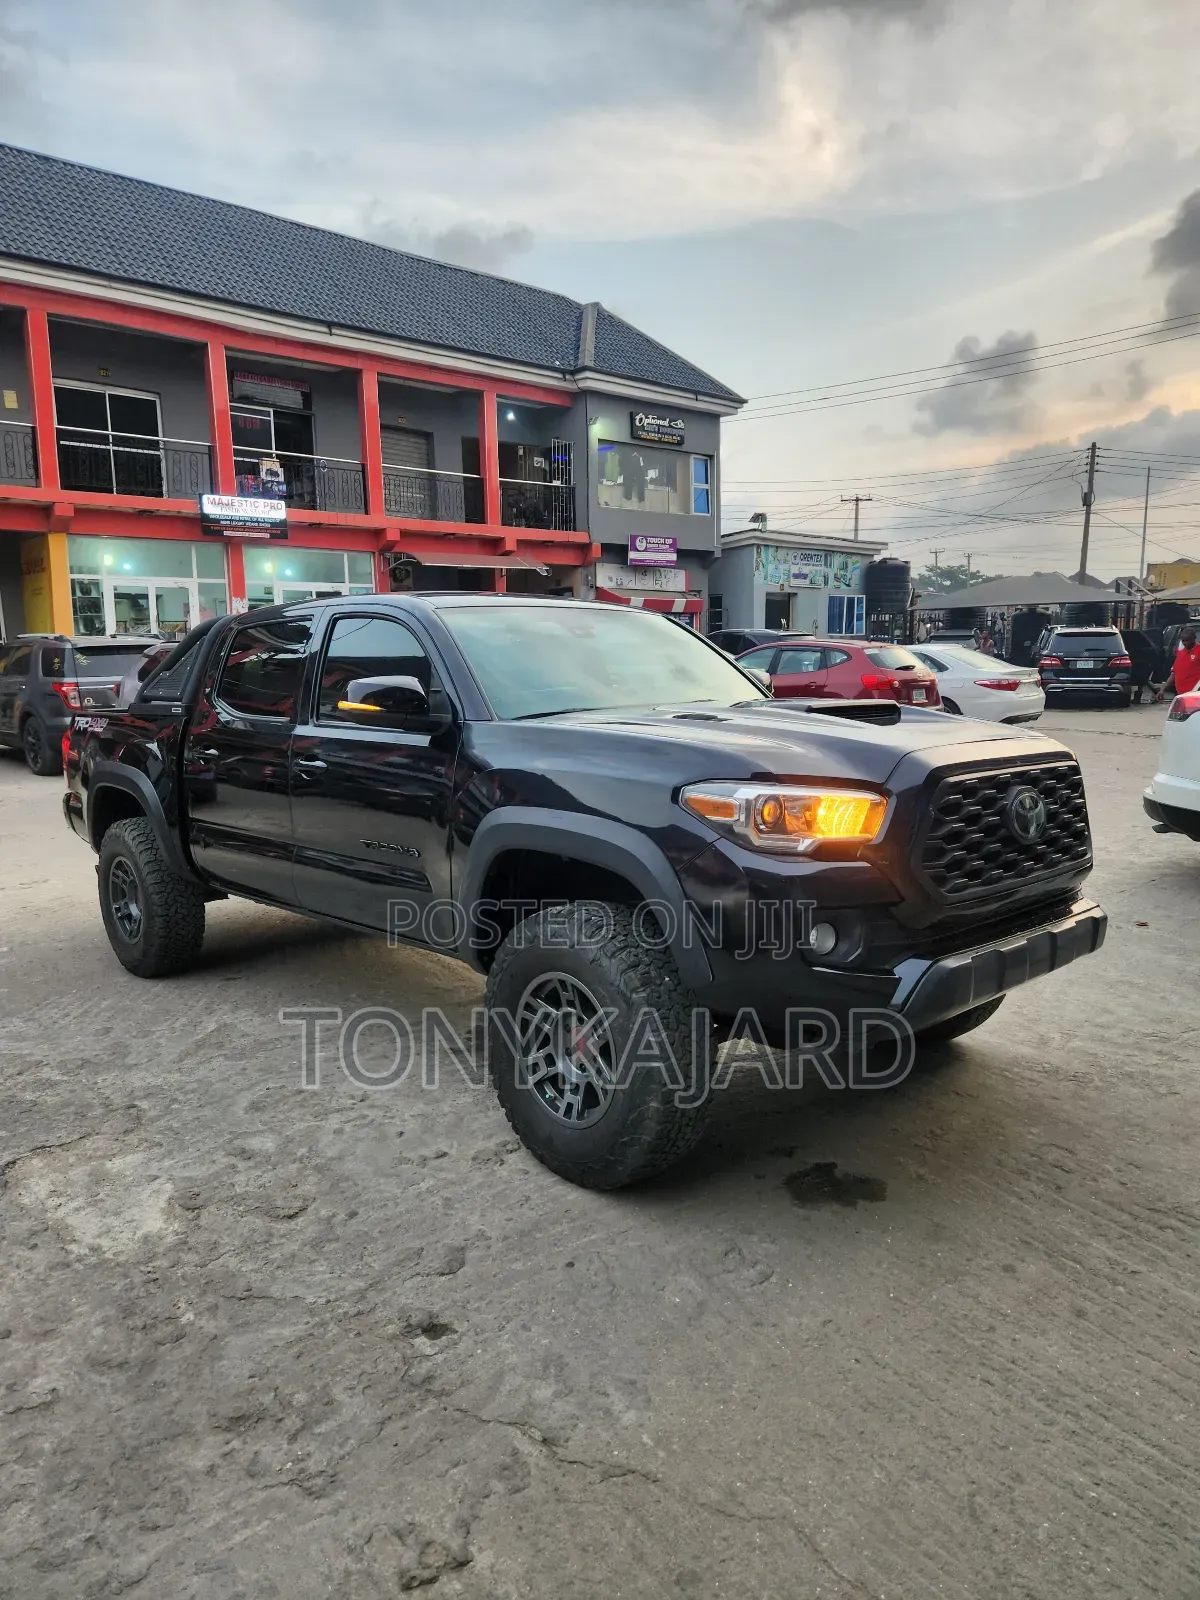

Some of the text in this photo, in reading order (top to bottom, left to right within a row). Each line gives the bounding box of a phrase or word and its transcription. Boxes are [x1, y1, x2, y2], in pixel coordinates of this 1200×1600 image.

[635, 412, 670, 427] Optional
[207, 496, 283, 511] MAJESTIC PRO
[75, 716, 92, 731] TRD
